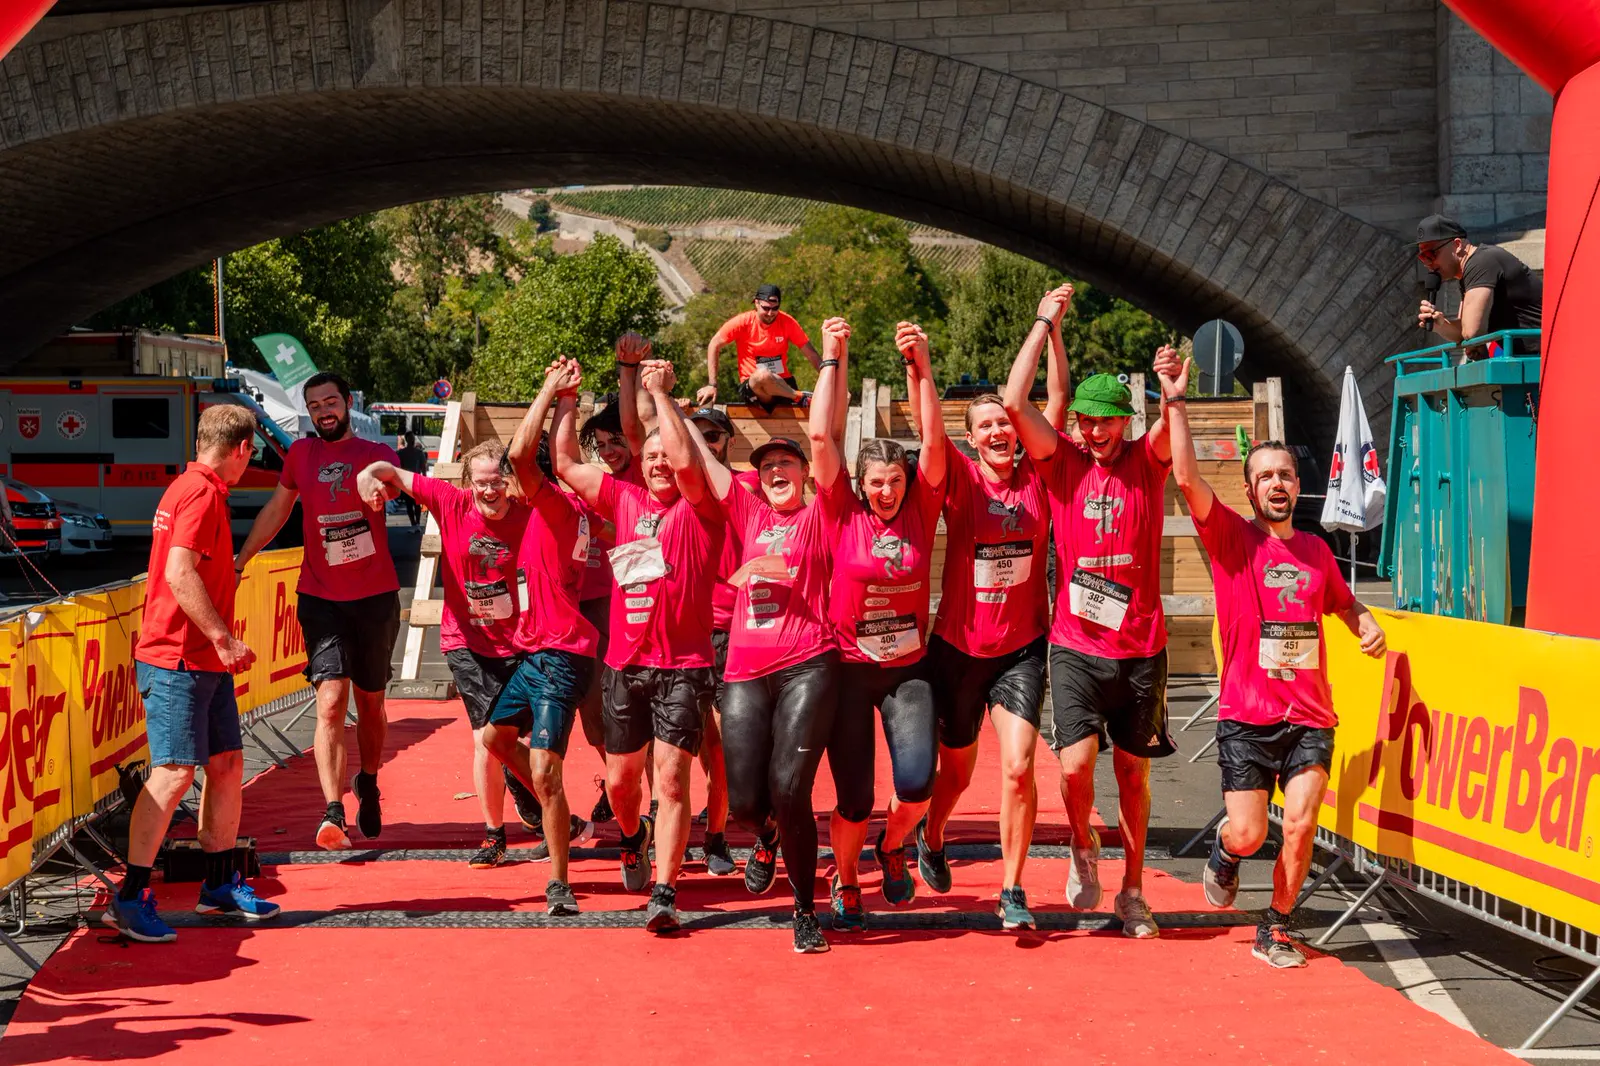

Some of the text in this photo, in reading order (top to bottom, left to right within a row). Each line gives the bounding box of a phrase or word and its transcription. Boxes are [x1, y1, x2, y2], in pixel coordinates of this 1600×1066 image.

[341, 538, 356, 548] 362
[996, 559, 1013, 569] 450
[478, 598, 494, 607] 389
[1087, 591, 1106, 605] 382
[1085, 600, 1102, 611] Robin
[880, 633, 897, 645] 400
[1283, 640, 1299, 650] 451
[1368, 649, 1600, 853] PowerBar
